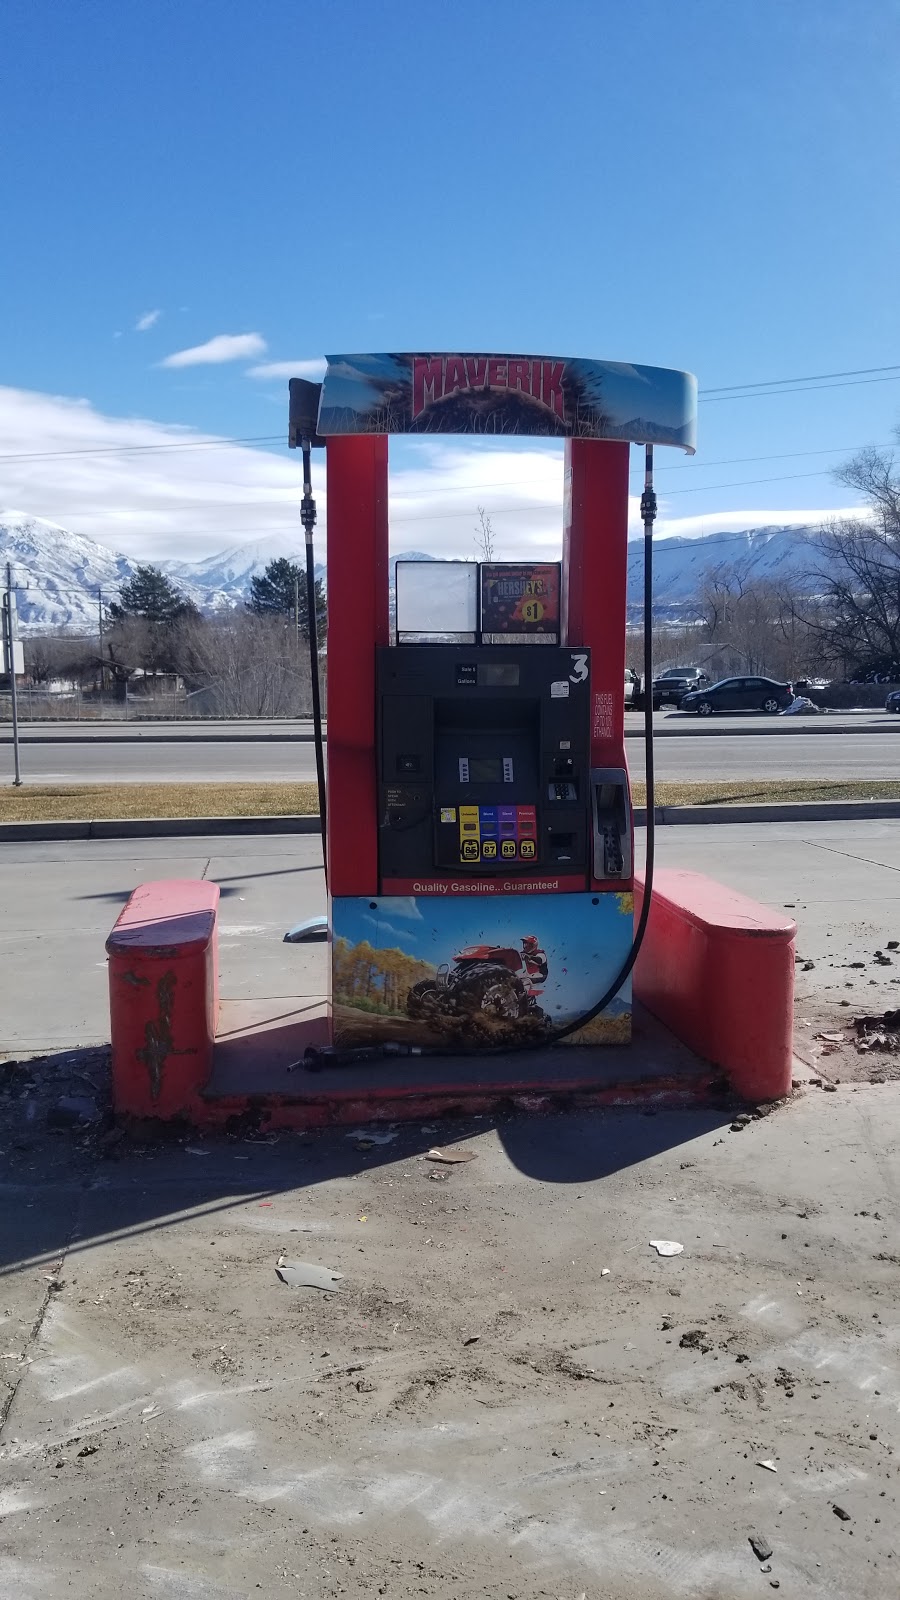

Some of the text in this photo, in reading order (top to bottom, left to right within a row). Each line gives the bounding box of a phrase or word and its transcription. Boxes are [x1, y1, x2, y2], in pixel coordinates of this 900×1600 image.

[411, 356, 566, 425] MAVERIK
[497, 580, 543, 595] HERSHEY'S
[526, 602, 538, 620] $1
[569, 654, 589, 684] 3
[484, 846, 495, 854] 87
[503, 846, 514, 854] 89
[522, 845, 534, 854] 91
[412, 882, 449, 894] Quality
